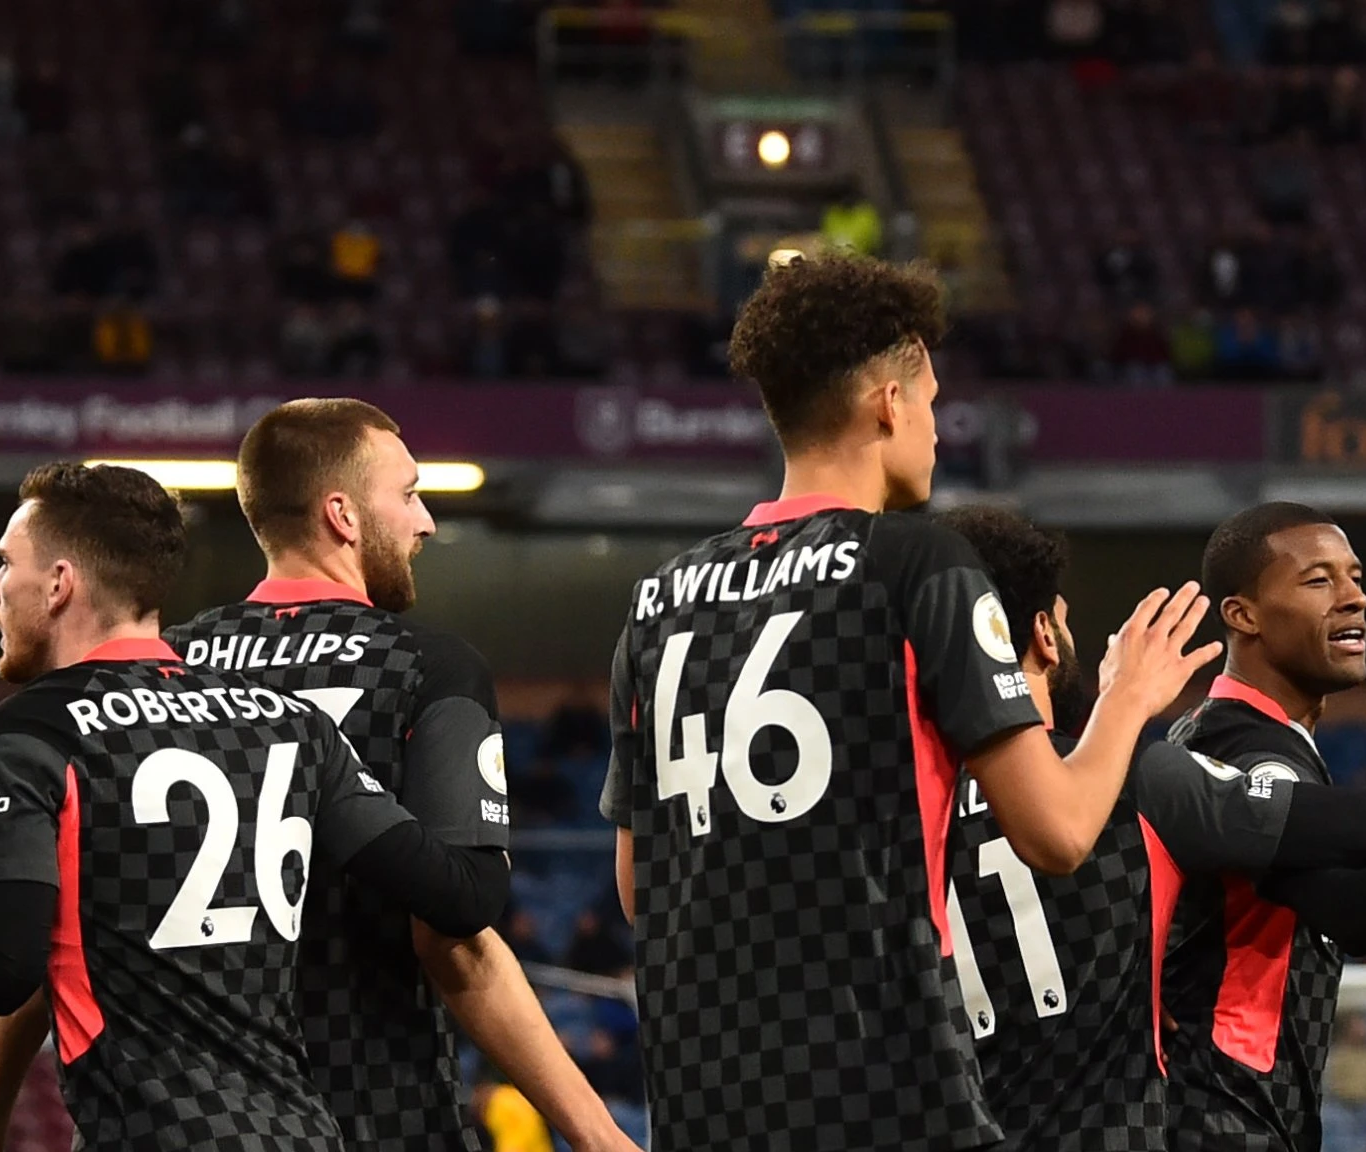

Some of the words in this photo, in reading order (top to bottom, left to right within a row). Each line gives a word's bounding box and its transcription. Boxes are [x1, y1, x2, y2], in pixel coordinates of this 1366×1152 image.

[185, 634, 371, 671] PHILLIPS
[654, 610, 833, 837] 46
[132, 742, 313, 950] 26
